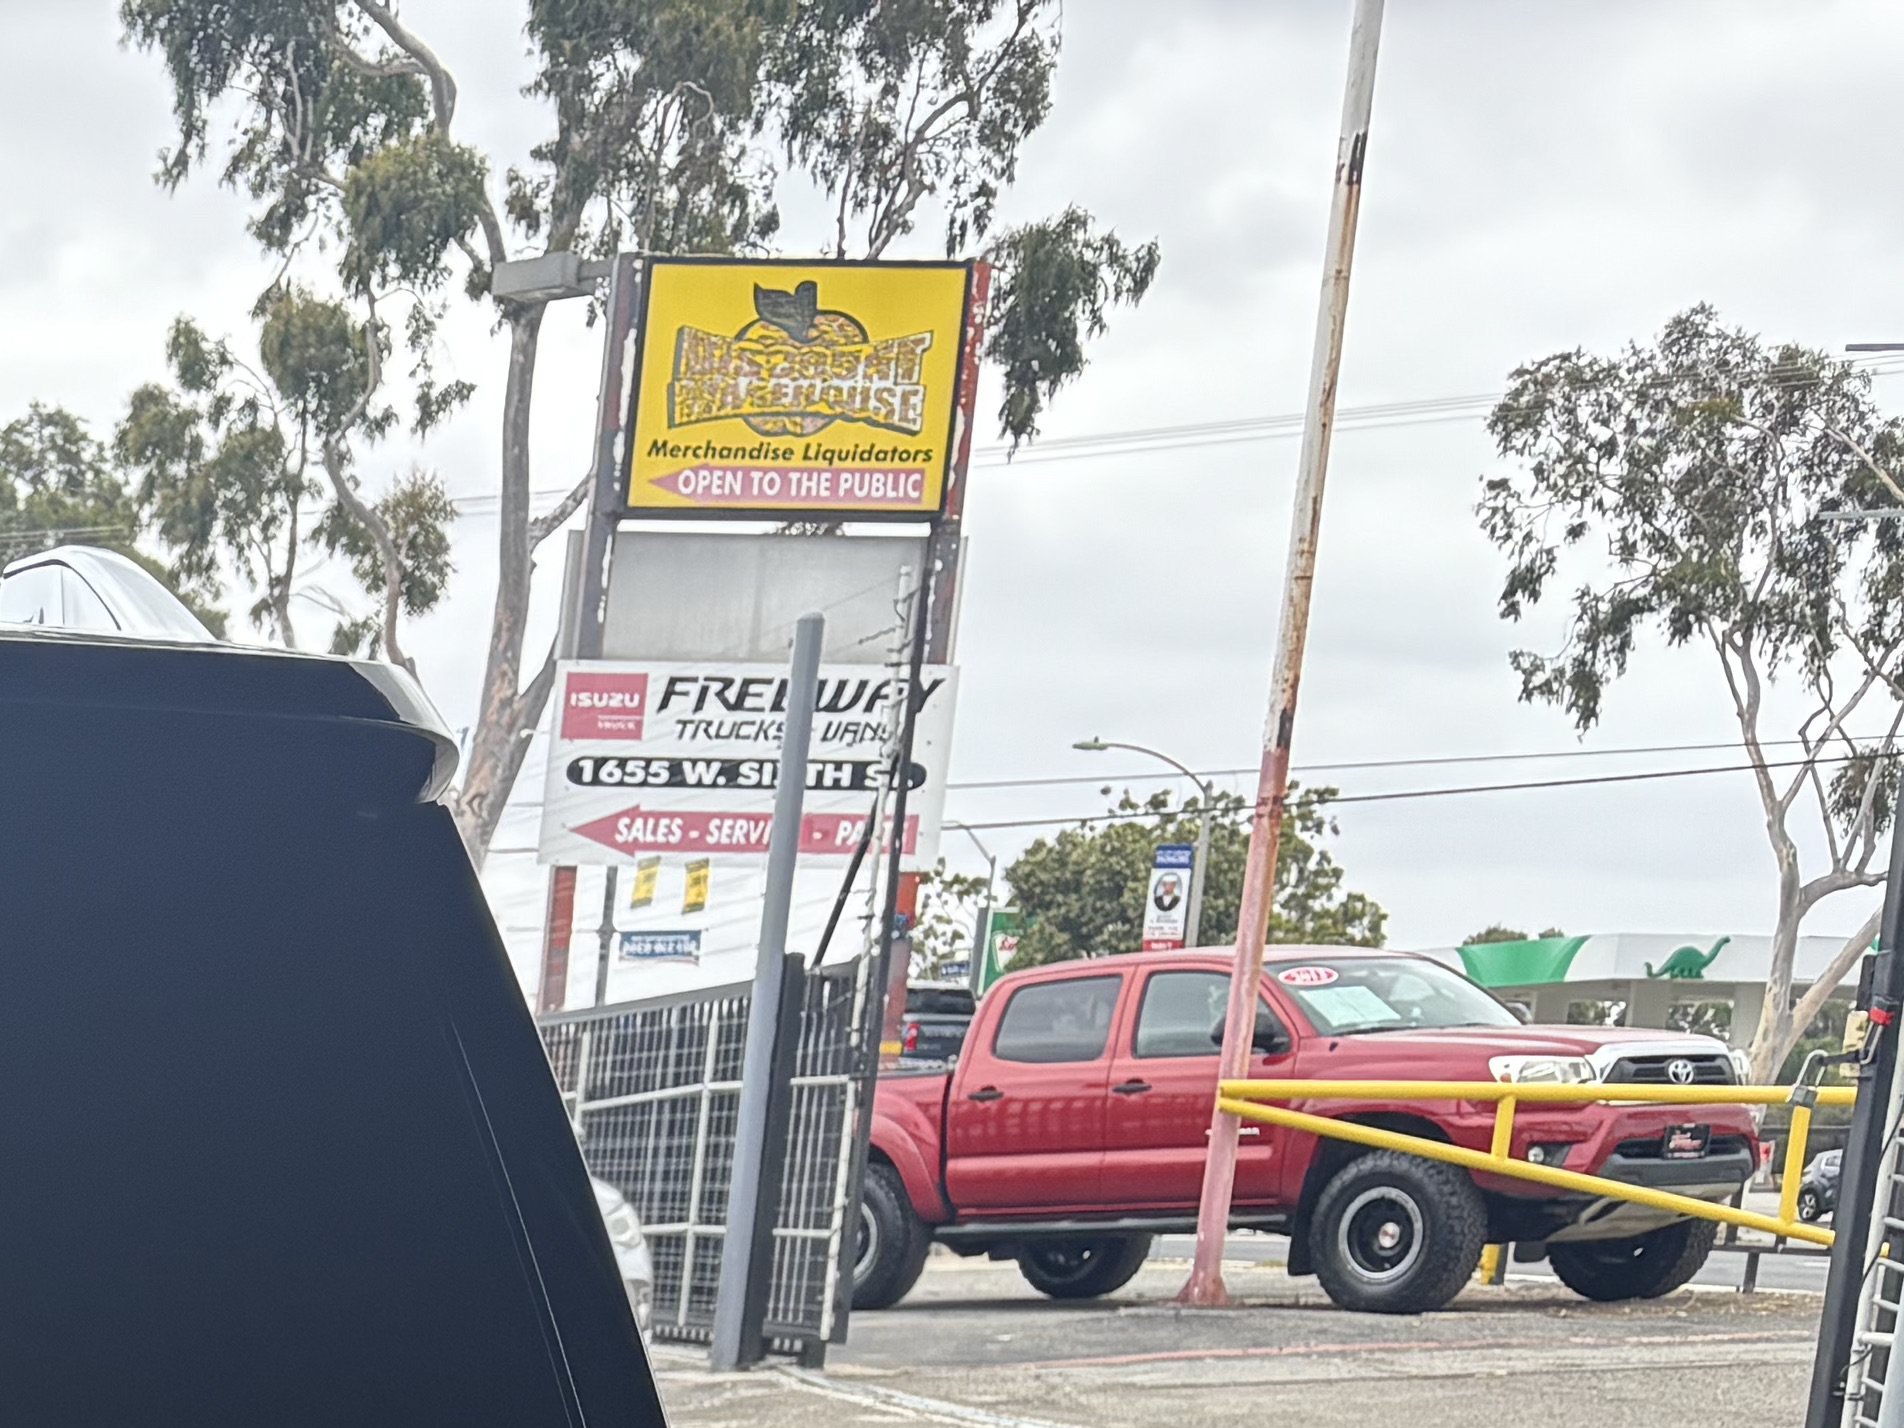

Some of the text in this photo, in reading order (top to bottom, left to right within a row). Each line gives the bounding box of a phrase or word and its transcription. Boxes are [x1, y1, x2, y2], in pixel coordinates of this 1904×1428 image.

[648, 439, 933, 466] Merchandise Liquidators
[677, 470, 922, 498] OPEN TO THE PUBLIC
[570, 691, 640, 708] ISUZU
[578, 759, 914, 788] 1655 W. SITH S.
[615, 817, 683, 844] SALES
[706, 818, 773, 845] SERVI
